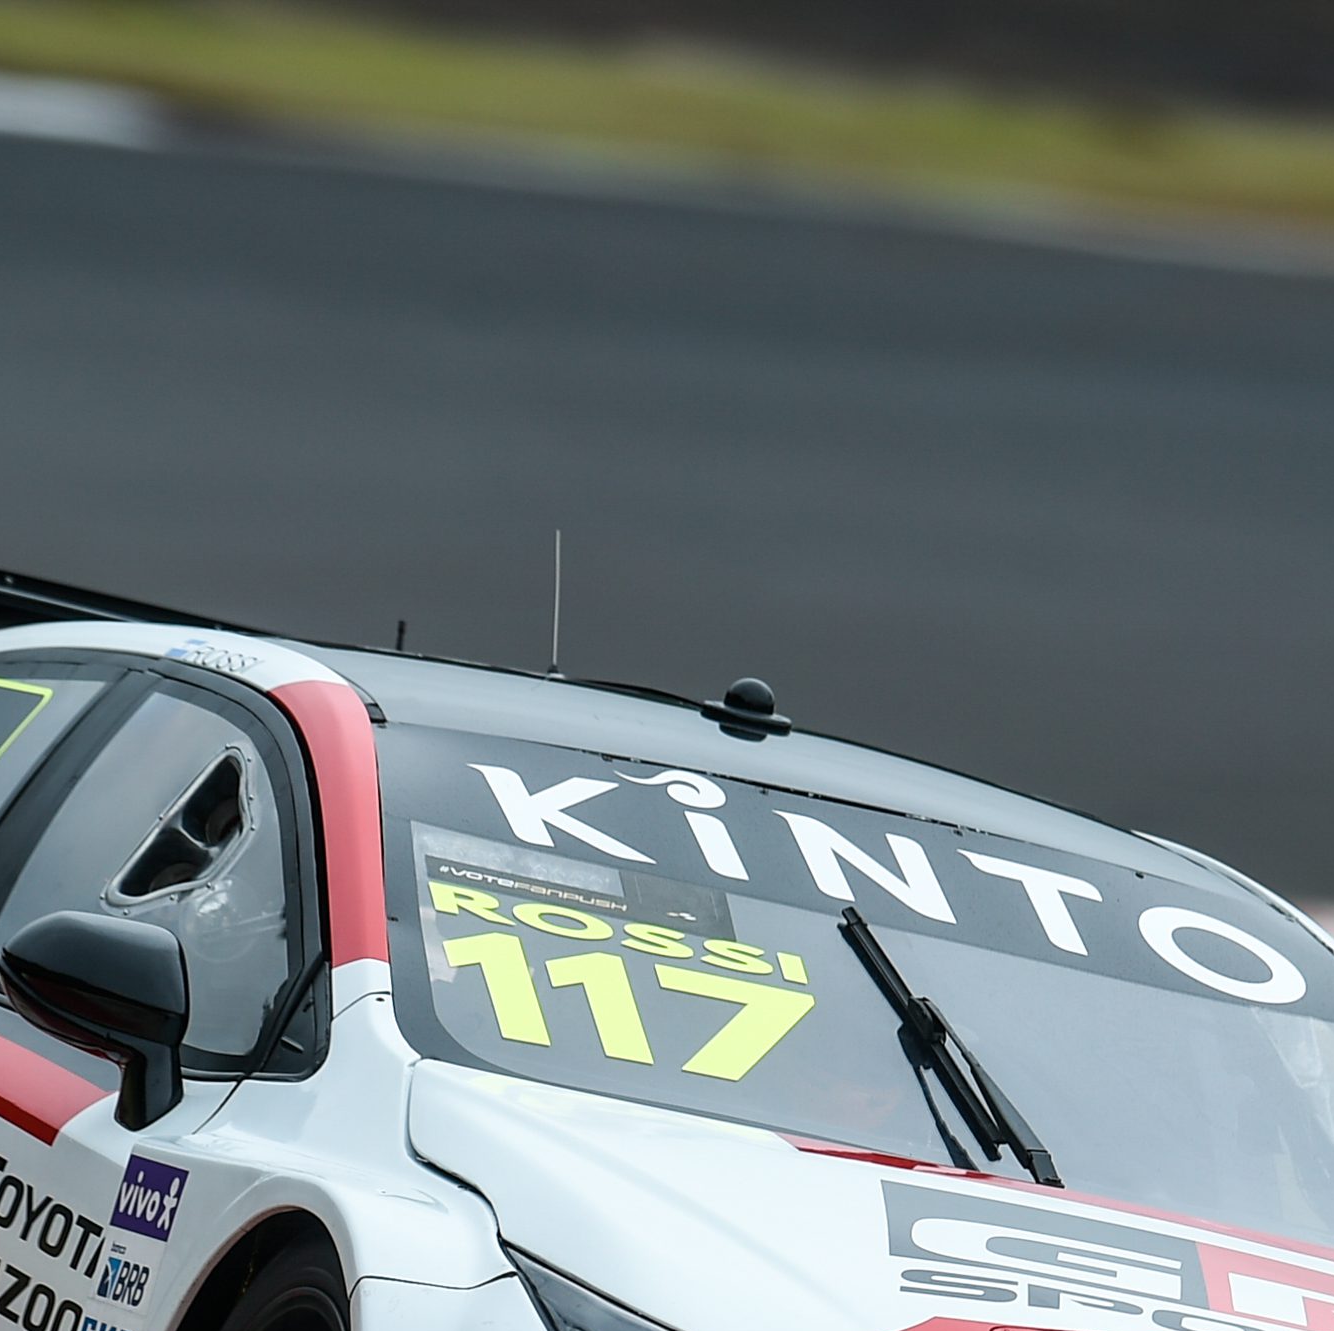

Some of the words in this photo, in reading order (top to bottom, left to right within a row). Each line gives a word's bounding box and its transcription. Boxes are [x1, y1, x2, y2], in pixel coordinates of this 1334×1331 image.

[427, 880, 810, 986] ROSSI
[442, 931, 816, 1082] 117
[118, 1170, 161, 1223] vivo
[111, 1260, 151, 1307] BRB
